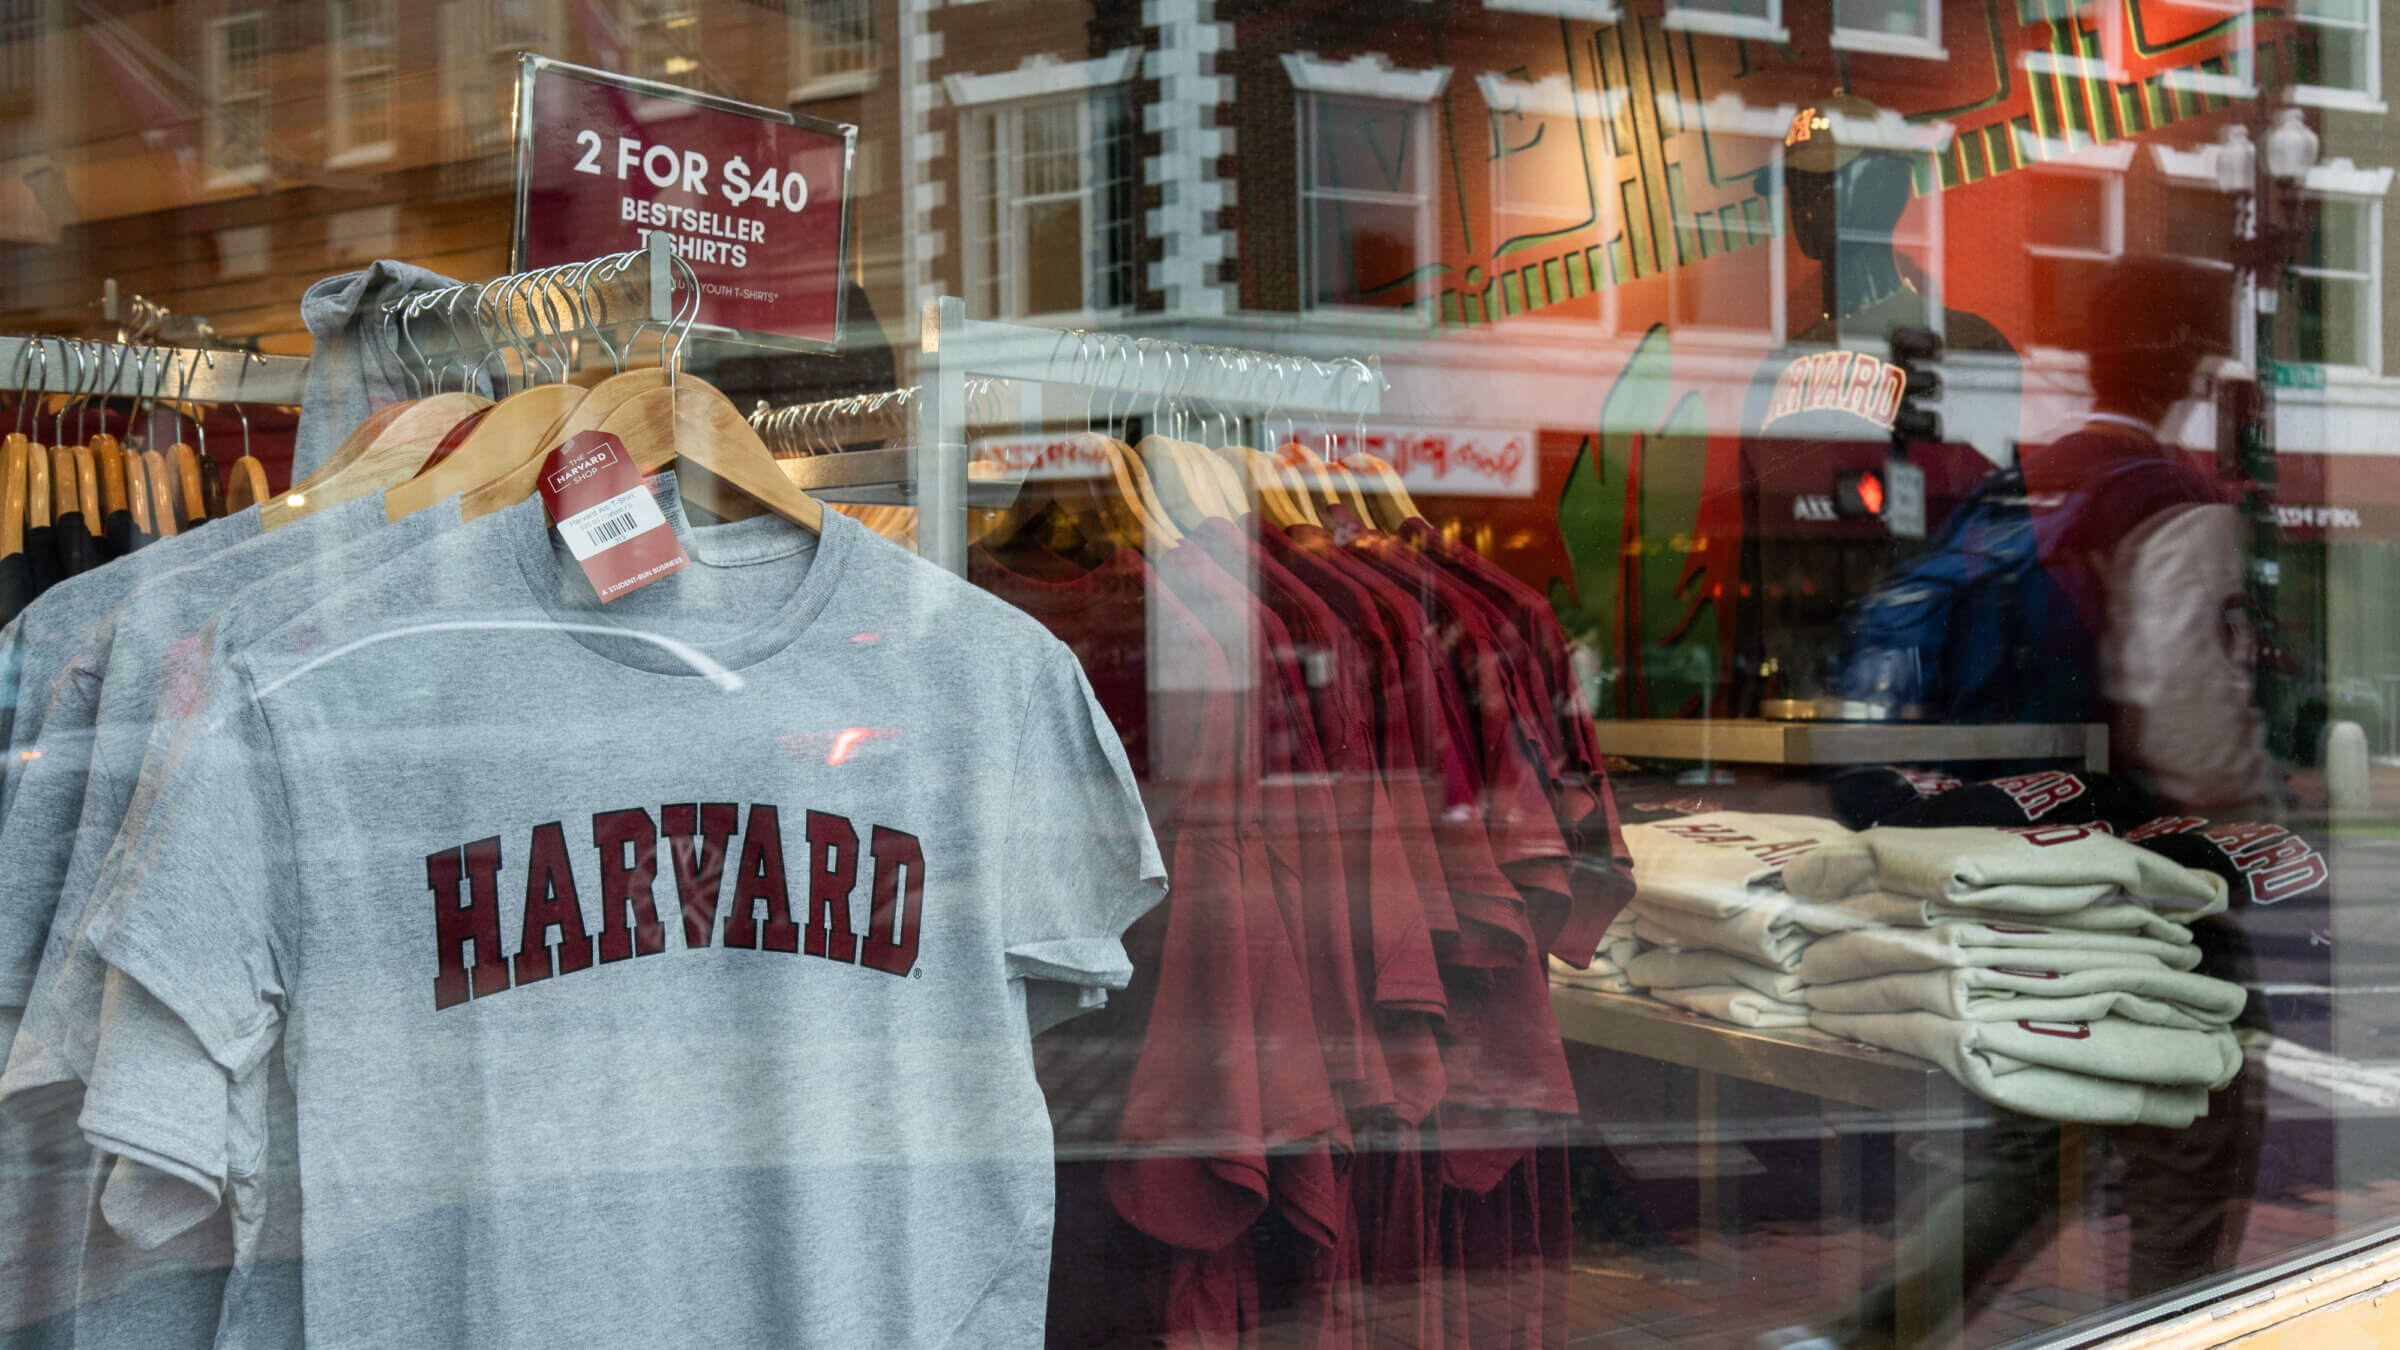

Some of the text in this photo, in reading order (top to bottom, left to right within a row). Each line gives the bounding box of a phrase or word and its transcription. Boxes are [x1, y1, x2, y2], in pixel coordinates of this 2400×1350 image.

[574, 129, 809, 213] 2 FOR $40
[621, 196, 766, 244] BESTSELLER
[636, 228, 748, 268] TSHIRTS
[700, 282, 733, 297] YOUTH
[556, 452, 607, 485] HARVARD
[569, 454, 585, 466] THE
[572, 467, 598, 484] SHOP
[425, 802, 926, 1012] HARVARD
